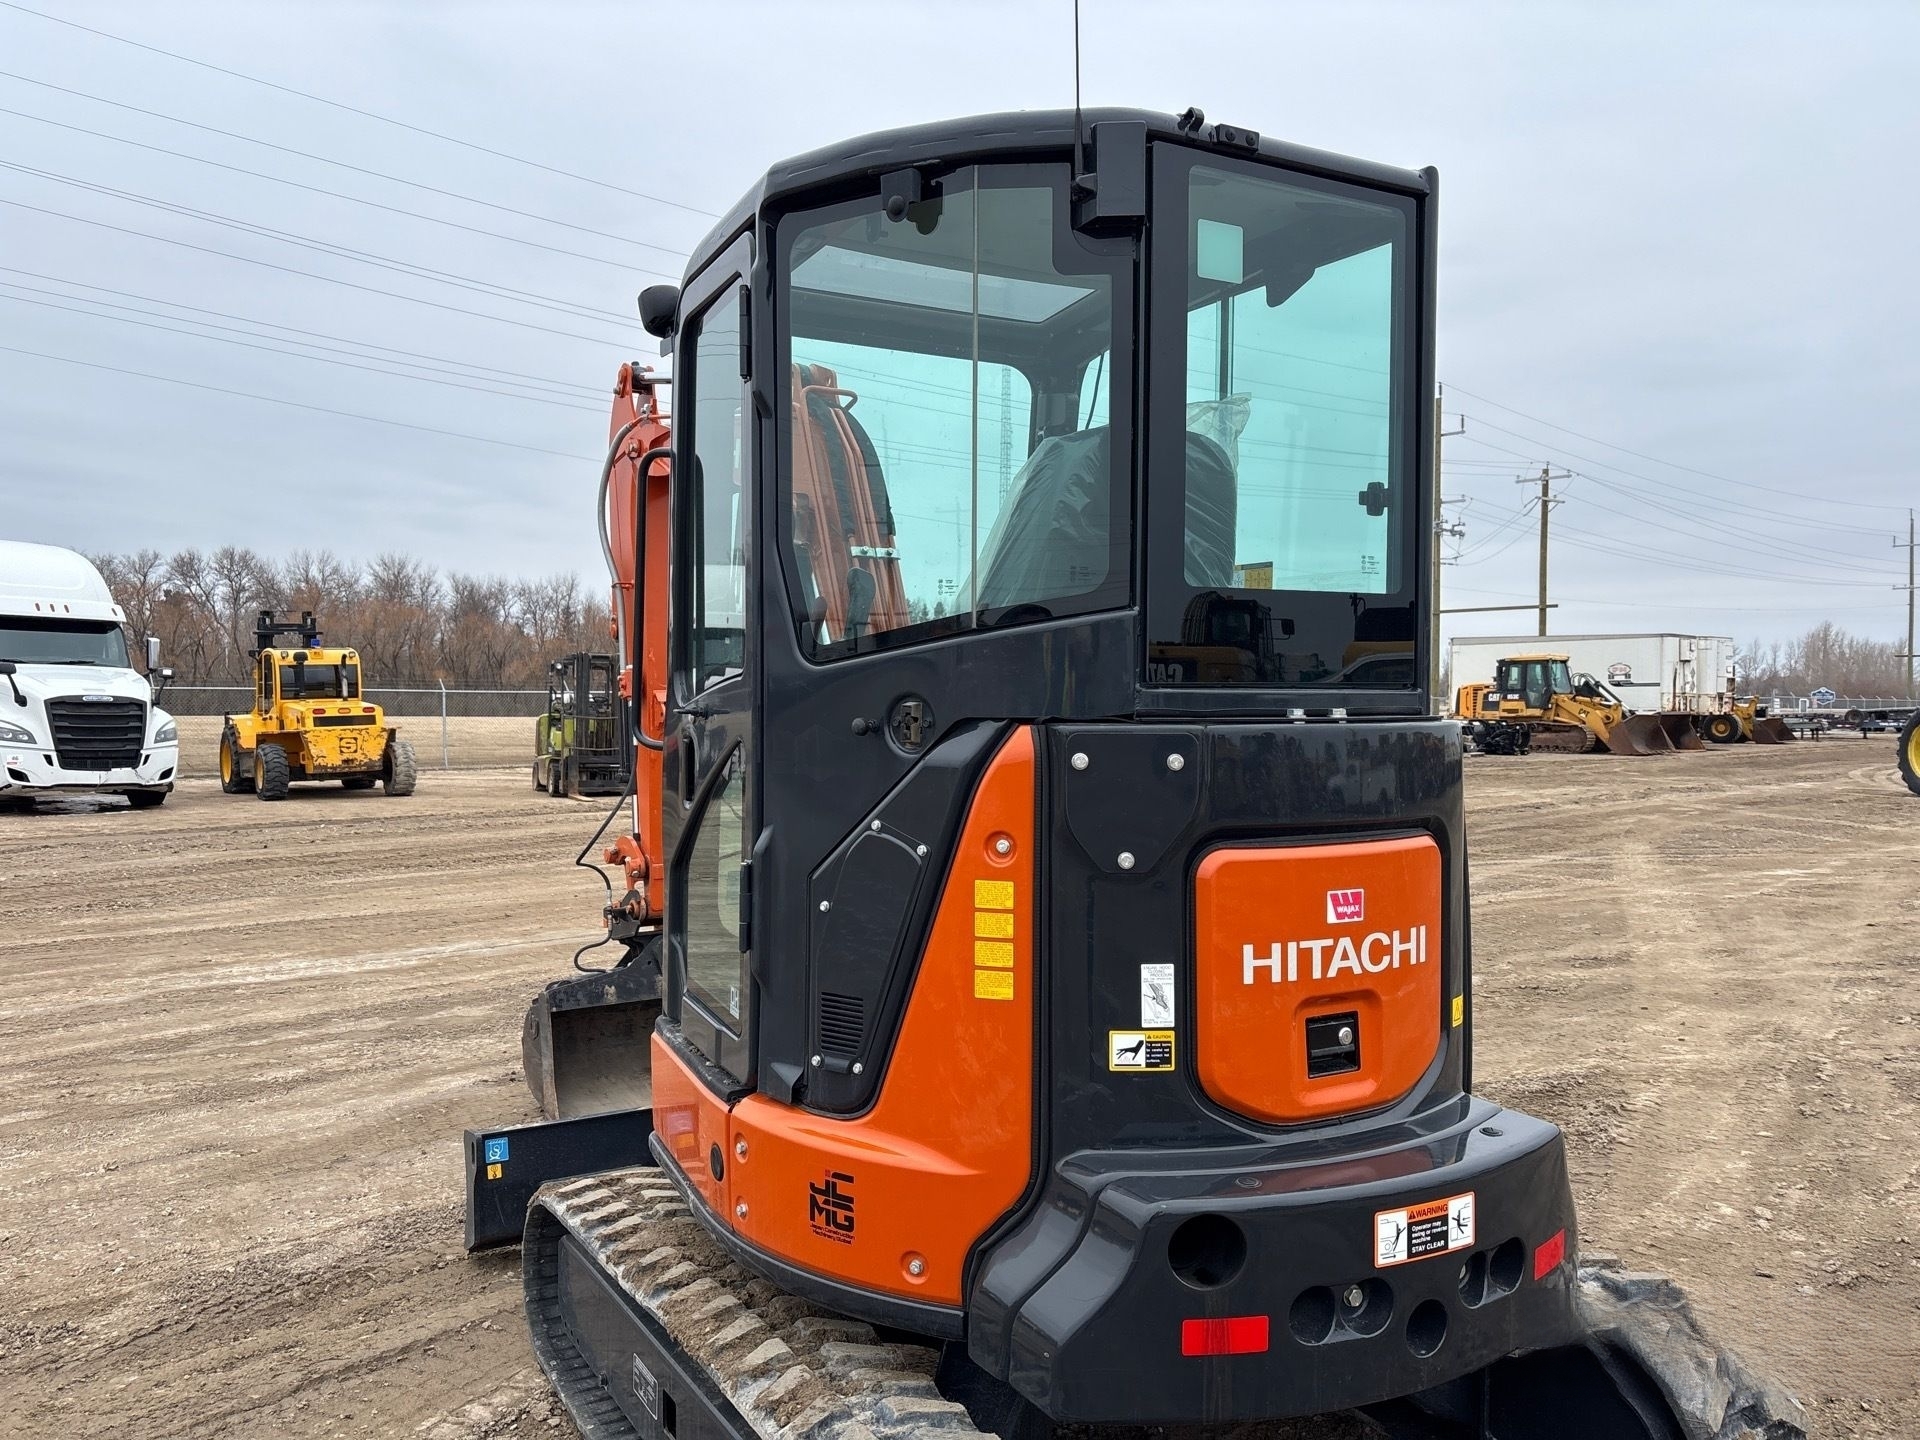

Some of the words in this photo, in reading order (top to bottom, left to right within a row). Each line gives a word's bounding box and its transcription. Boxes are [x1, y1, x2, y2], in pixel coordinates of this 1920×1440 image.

[1488, 692, 1500, 701] CAT
[1578, 707, 1590, 718] CAT
[1336, 904, 1360, 915] WAJAX
[1242, 925, 1426, 985] HITACHI
[1415, 1203, 1448, 1218] WARNING
[823, 1227, 855, 1239] Construction
[1411, 1223, 1432, 1232] Operator
[1411, 1230, 1425, 1238] swing
[1431, 1225, 1448, 1234] reverse
[1411, 1236, 1431, 1244] machine
[1411, 1244, 1426, 1253] STAY
[1426, 1240, 1445, 1250] CLEAR
